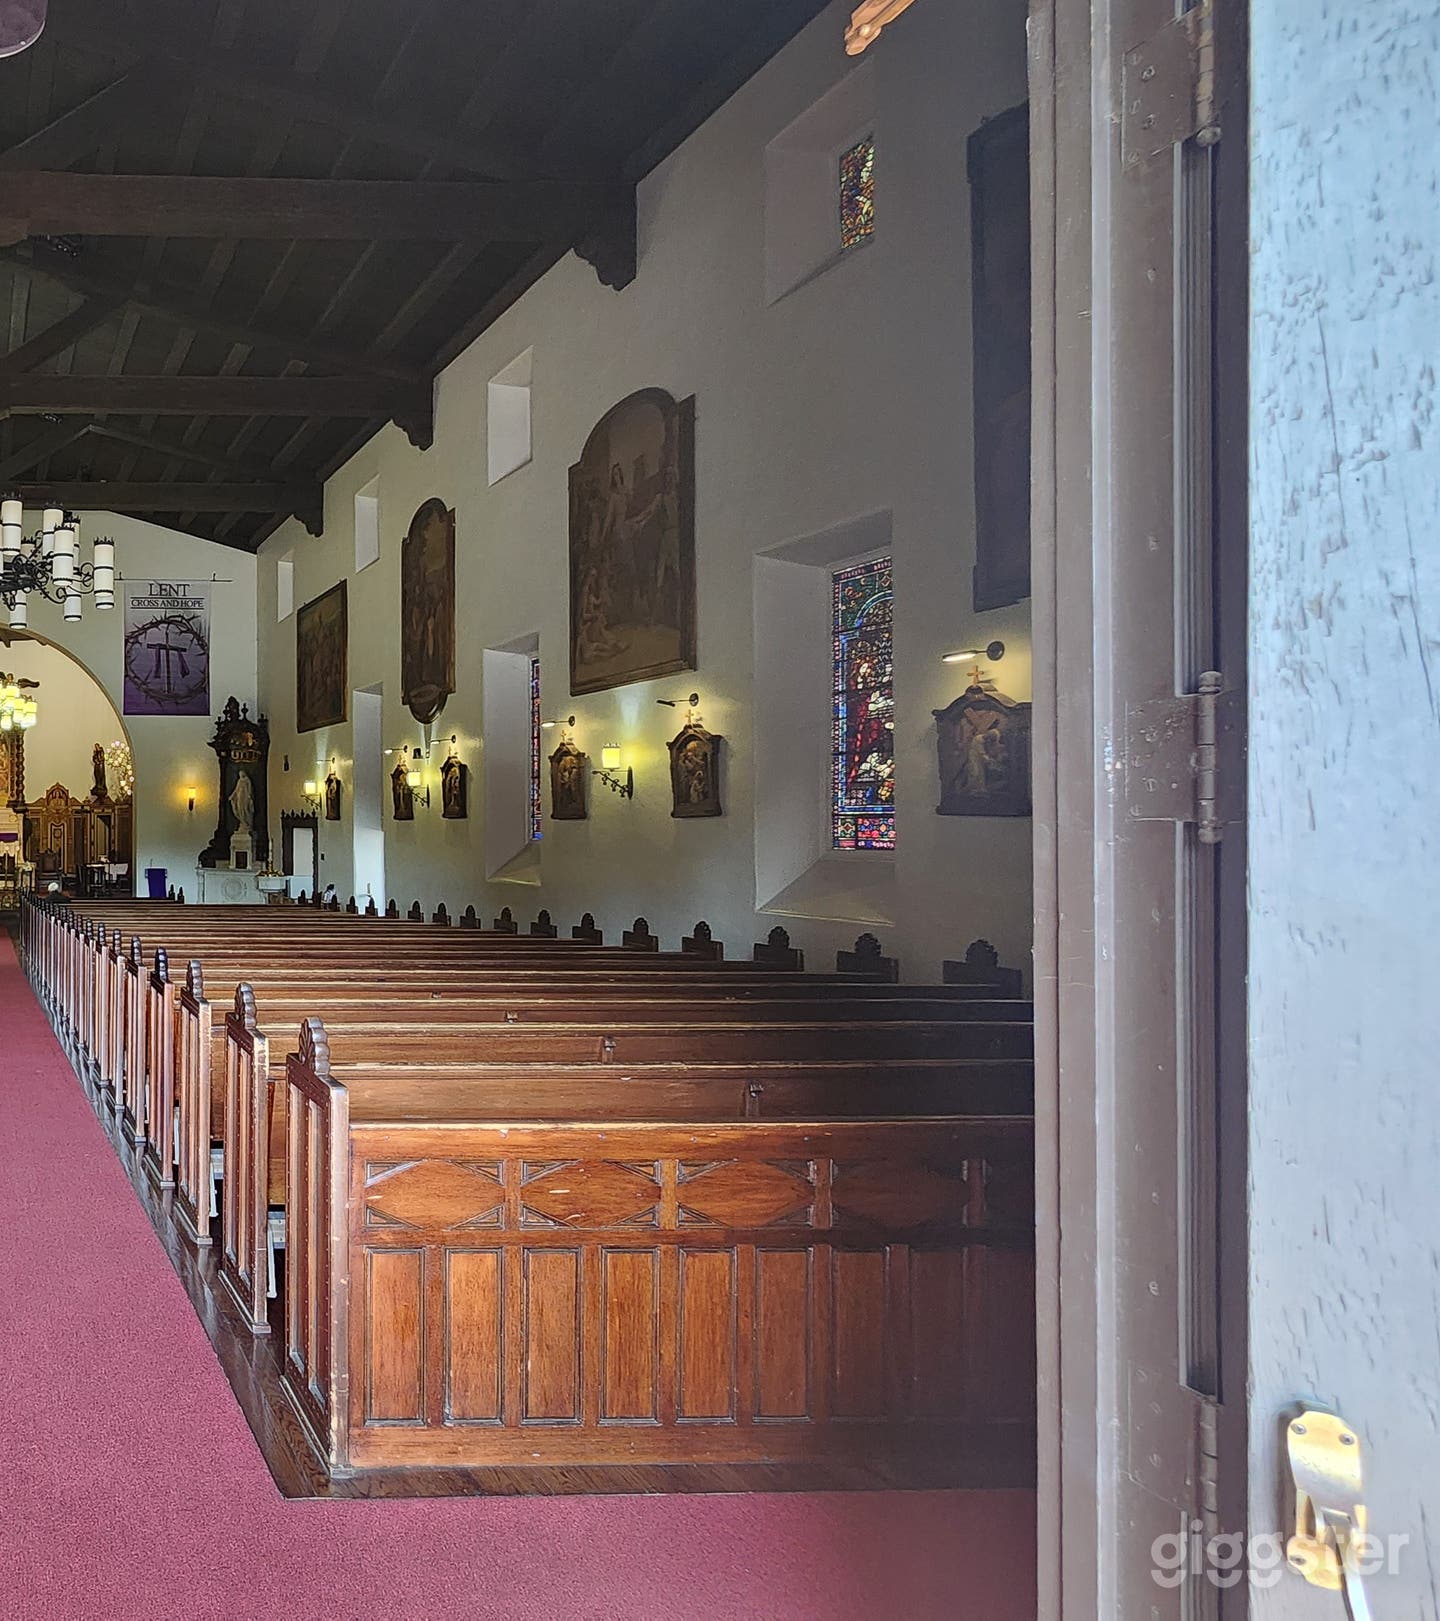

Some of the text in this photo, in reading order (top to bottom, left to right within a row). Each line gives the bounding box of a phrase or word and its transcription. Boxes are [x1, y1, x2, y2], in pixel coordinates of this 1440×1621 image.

[148, 583, 190, 597] LENT
[131, 599, 203, 608] CROSS AND HOPE
